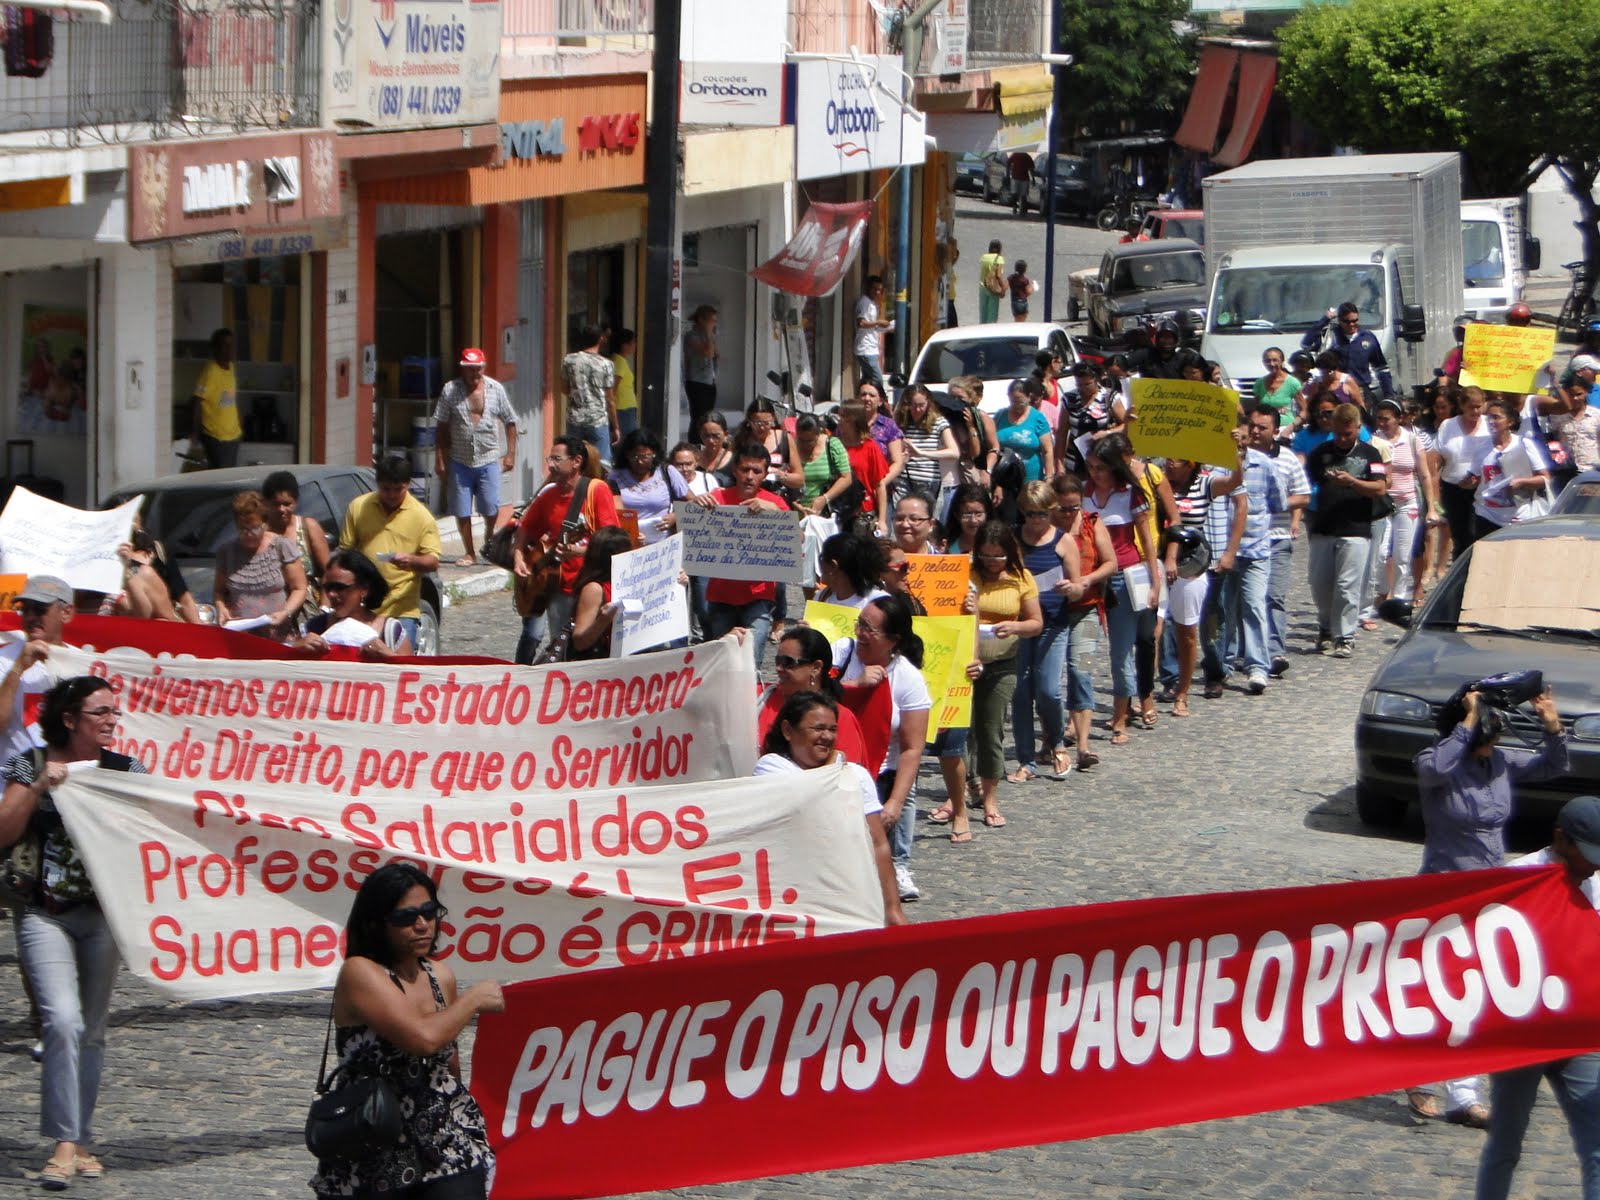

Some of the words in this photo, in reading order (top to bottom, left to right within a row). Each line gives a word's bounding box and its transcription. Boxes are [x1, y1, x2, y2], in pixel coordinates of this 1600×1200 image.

[406, 14, 464, 53] Móveis
[378, 82, 403, 119] (88)
[407, 86, 461, 115] 441.0339
[689, 82, 767, 97] Ortobom
[920, 558, 962, 573] retrai
[934, 581, 959, 590] na
[127, 665, 263, 717] vivemos
[267, 679, 323, 720] em
[326, 680, 385, 723] um
[392, 671, 531, 725] Estado
[537, 651, 703, 725] Democrá-
[163, 727, 205, 779] de
[208, 729, 345, 793] Direito,
[349, 747, 428, 797] por
[430, 750, 505, 797] que
[511, 751, 537, 791] o
[545, 726, 693, 790] Servidor
[341, 798, 582, 864] Salarial
[591, 794, 709, 858] dos
[148, 915, 259, 981] Sua
[558, 907, 604, 967] é
[501, 999, 732, 1139] PAGUE
[724, 989, 784, 1099] O
[780, 968, 938, 1097] PISO
[945, 958, 1038, 1079] OU
[1040, 933, 1240, 1075] PAGUE
[1241, 930, 1295, 1052] O
[1301, 903, 1565, 1047] PREÇO.
